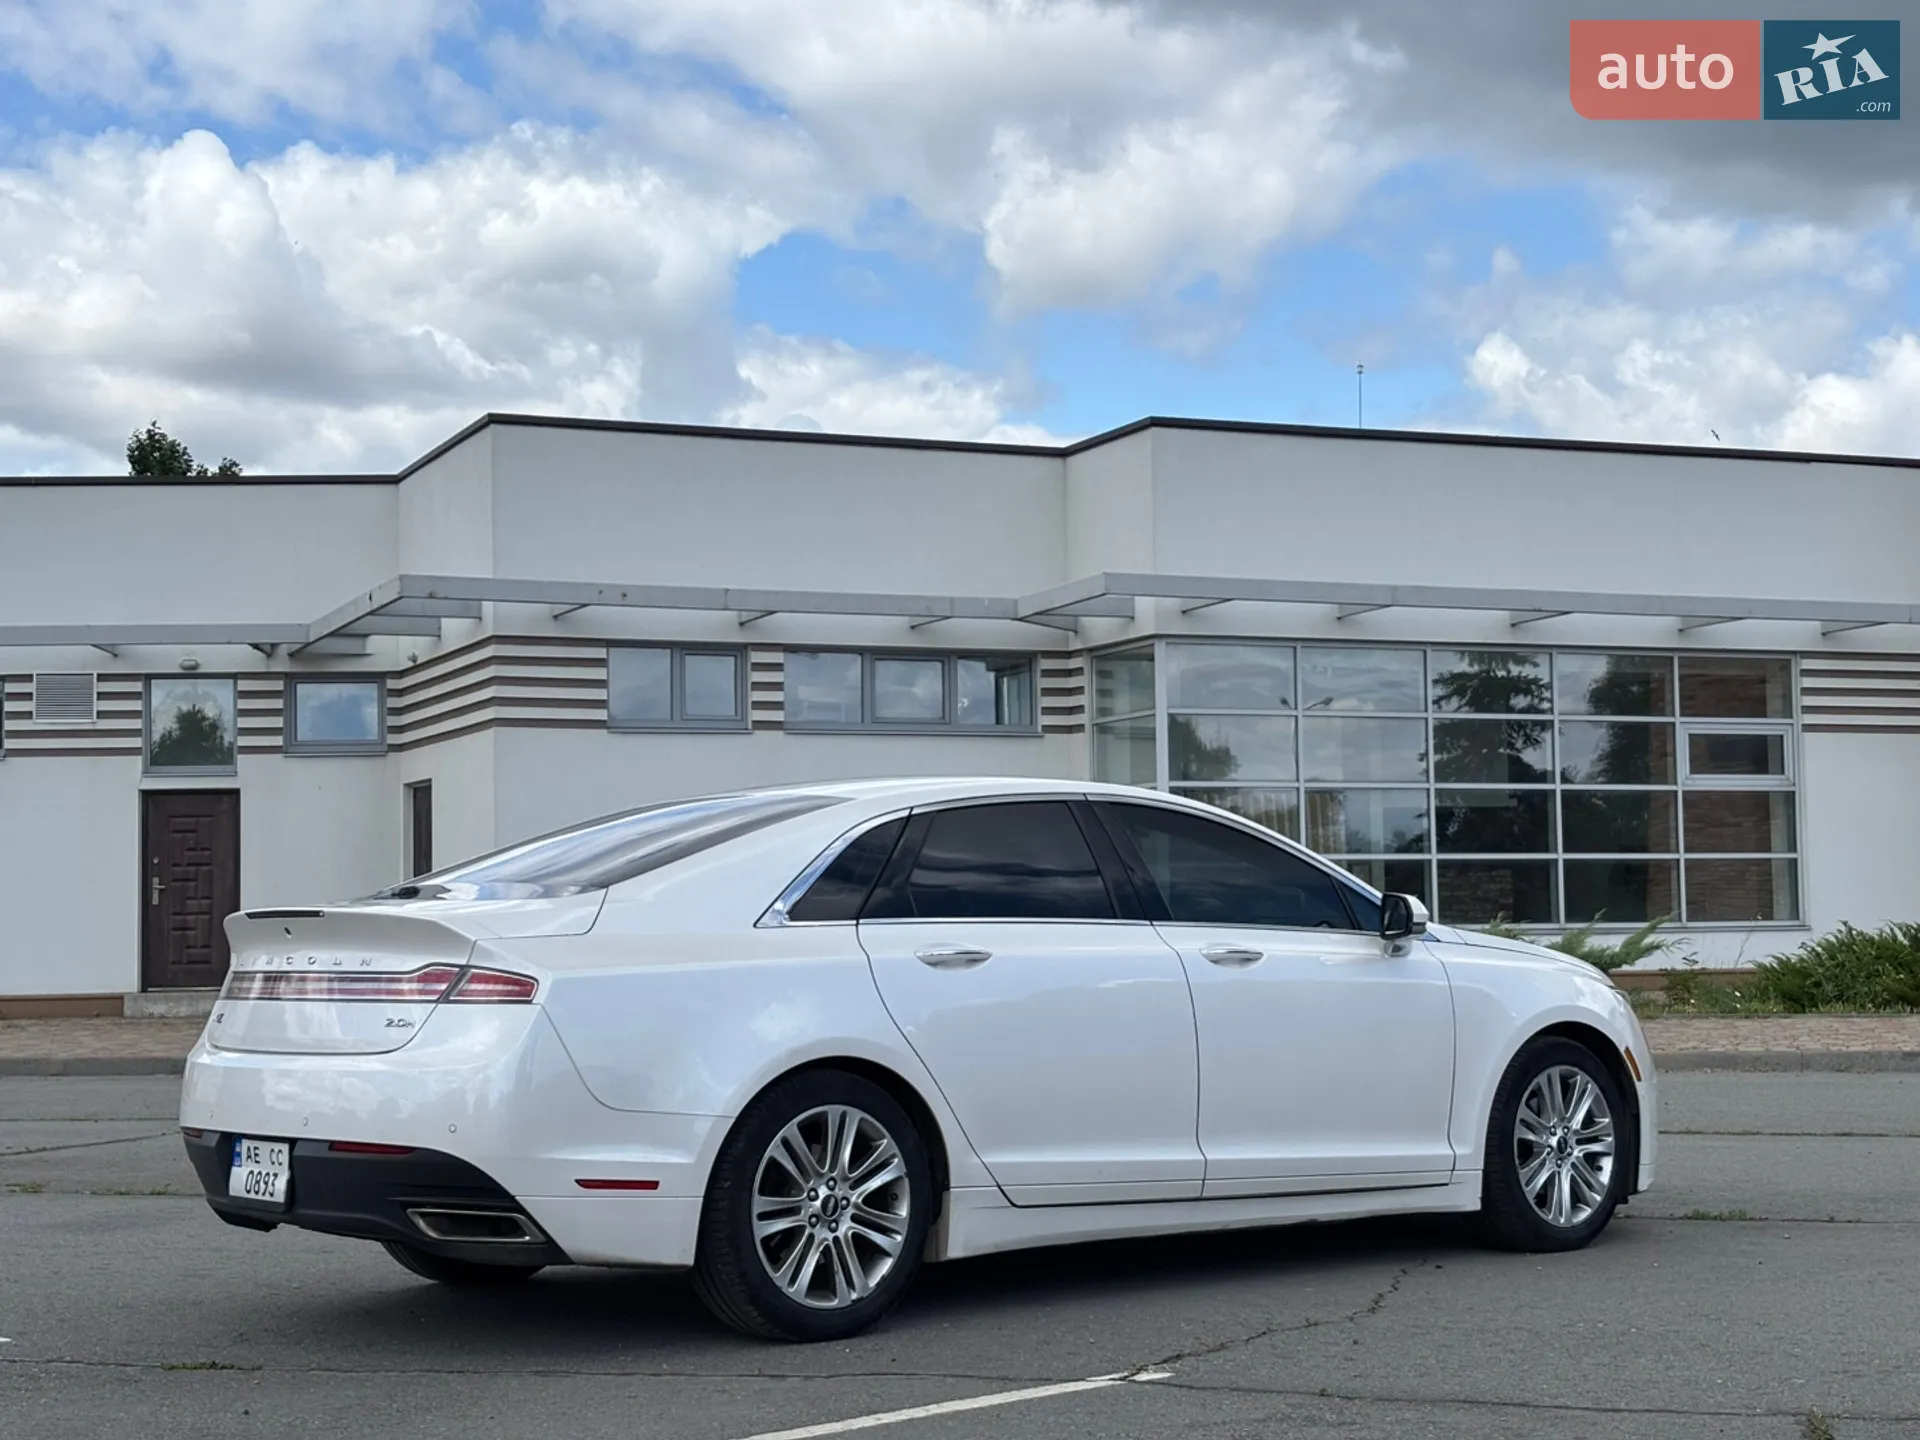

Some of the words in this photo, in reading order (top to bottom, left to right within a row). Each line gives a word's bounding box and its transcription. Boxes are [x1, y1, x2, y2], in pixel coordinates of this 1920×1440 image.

[246, 1145, 261, 1164] AE
[269, 1147, 284, 1167] CC
[244, 1169, 279, 1198] 0893
